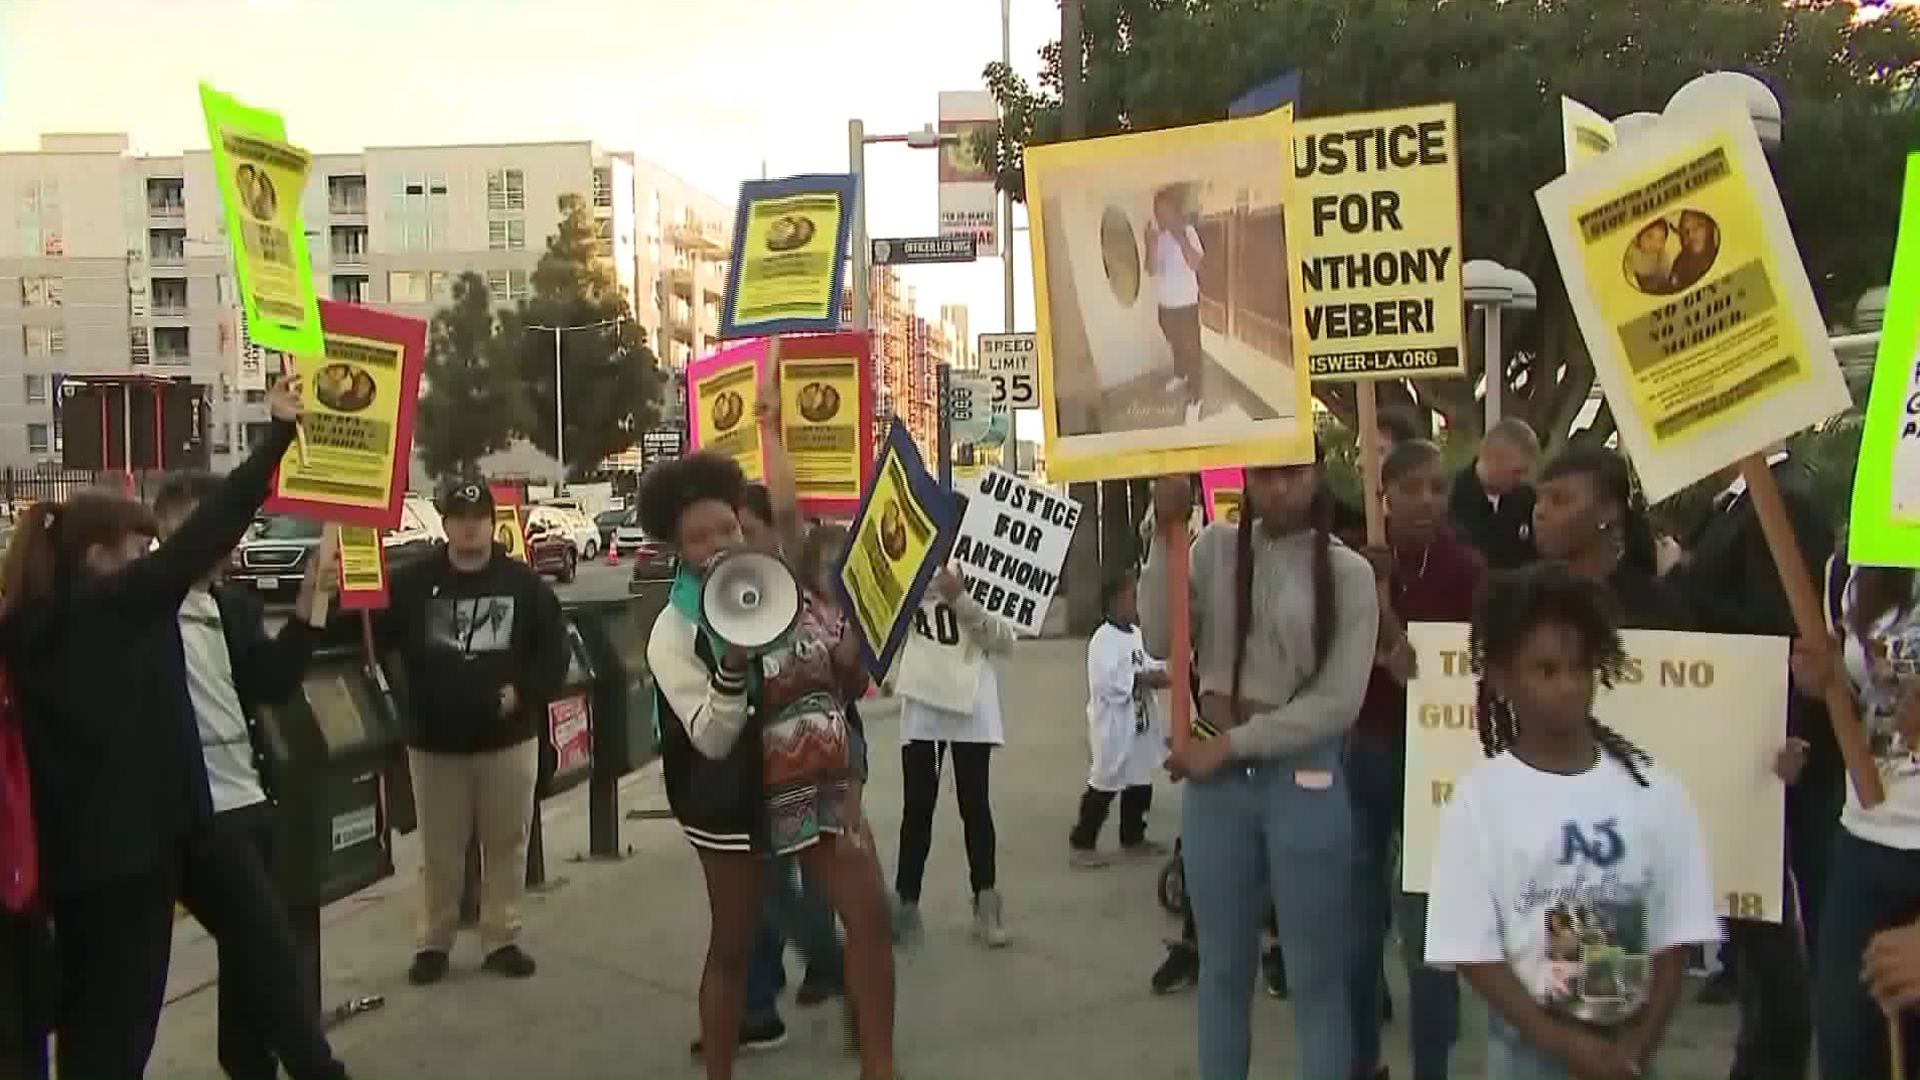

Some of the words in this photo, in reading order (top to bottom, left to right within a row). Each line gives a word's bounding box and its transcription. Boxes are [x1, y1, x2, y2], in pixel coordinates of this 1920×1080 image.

[1294, 120, 1448, 178] USTICE
[1312, 190, 1403, 237] FOR
[1301, 246, 1453, 293] NTHONY
[983, 340, 1034, 353] SPEED
[989, 356, 1028, 370] LIMIT
[1310, 350, 1438, 373] SWER-LA.ORG
[990, 375, 1032, 402] 35
[980, 472, 1078, 531] JUSTICE
[994, 512, 1043, 553] FOR
[953, 534, 1057, 597] ANTHONY
[1660, 660, 1715, 688] NO
